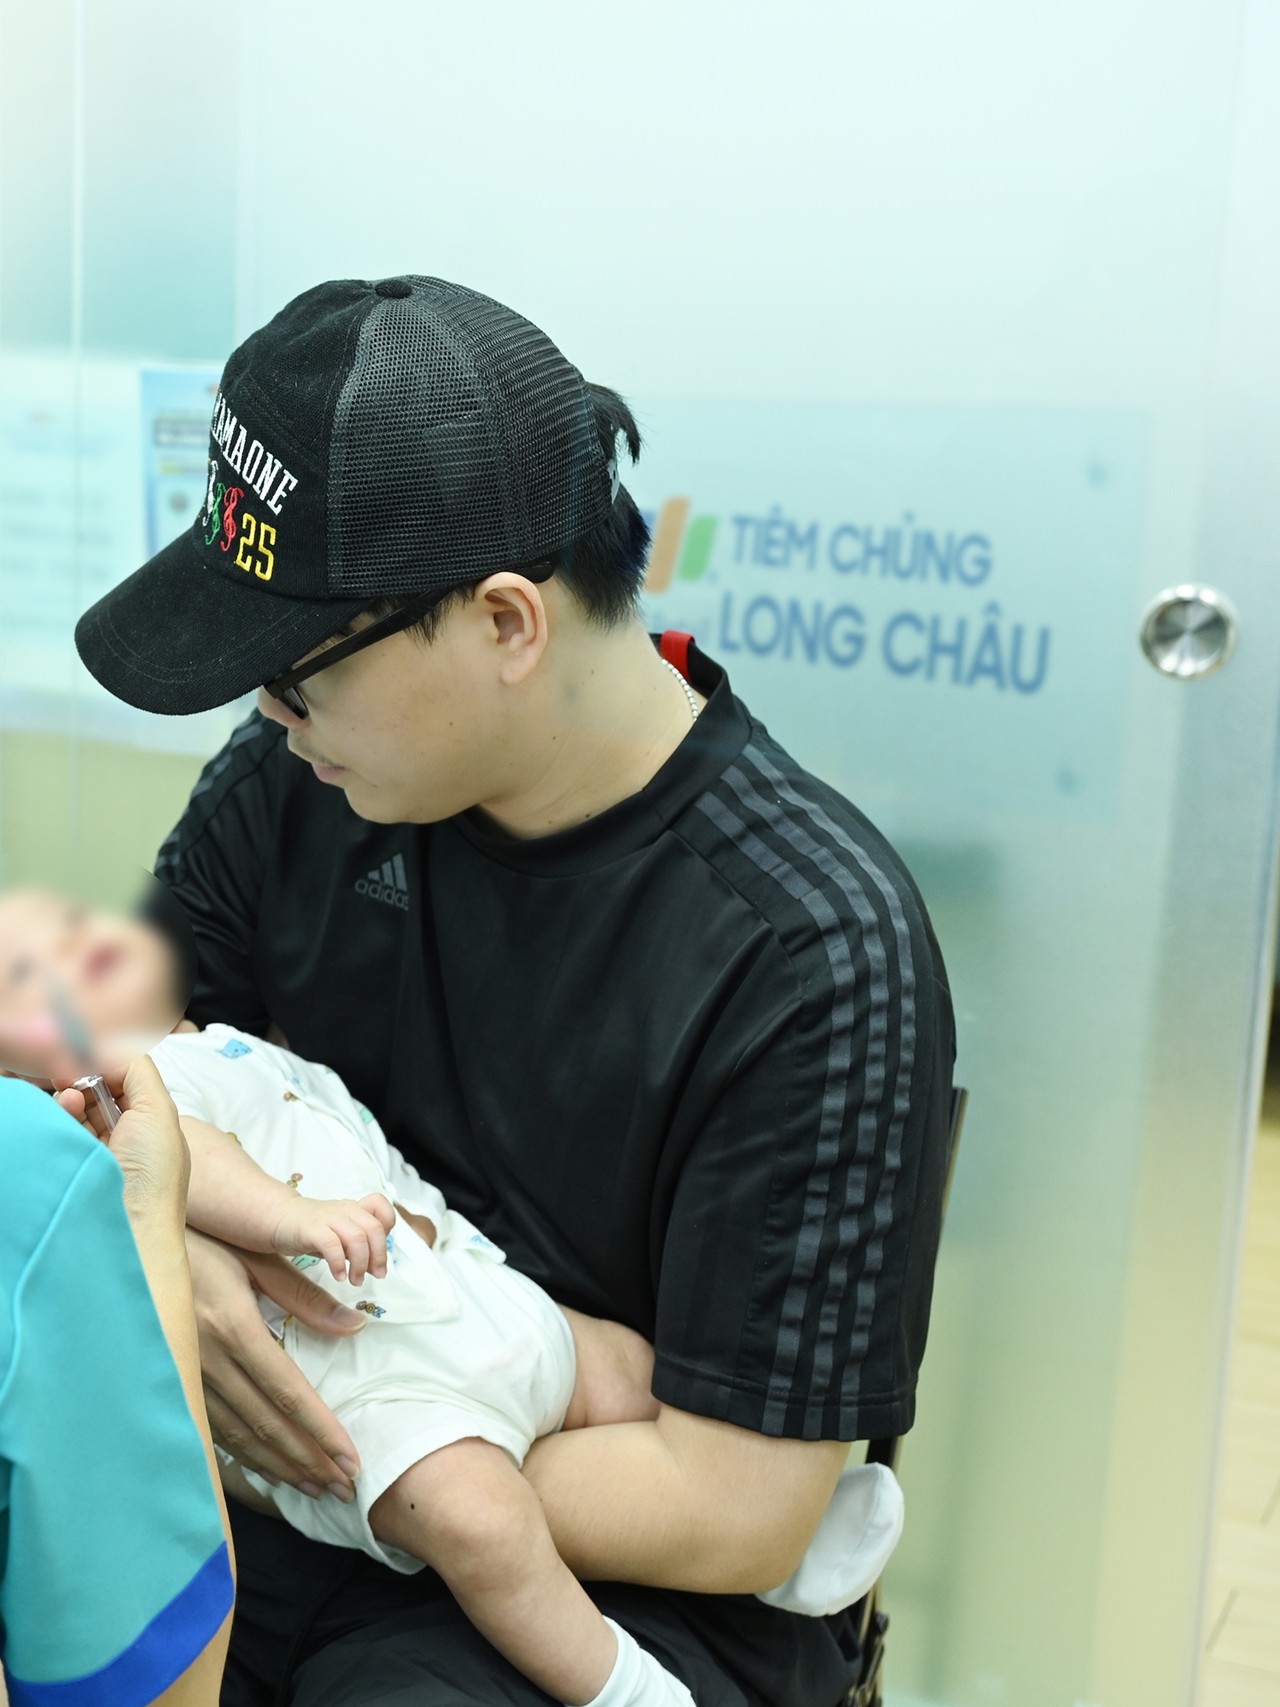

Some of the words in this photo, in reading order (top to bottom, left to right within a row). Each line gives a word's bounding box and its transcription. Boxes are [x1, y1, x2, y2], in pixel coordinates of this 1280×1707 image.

[209, 392, 299, 516] AMAONE
[234, 512, 277, 581] 25
[731, 503, 820, 573] TIÊM
[719, 591, 867, 668] LONG
[881, 600, 1052, 695] CHÂU
[354, 879, 409, 911] adidas
